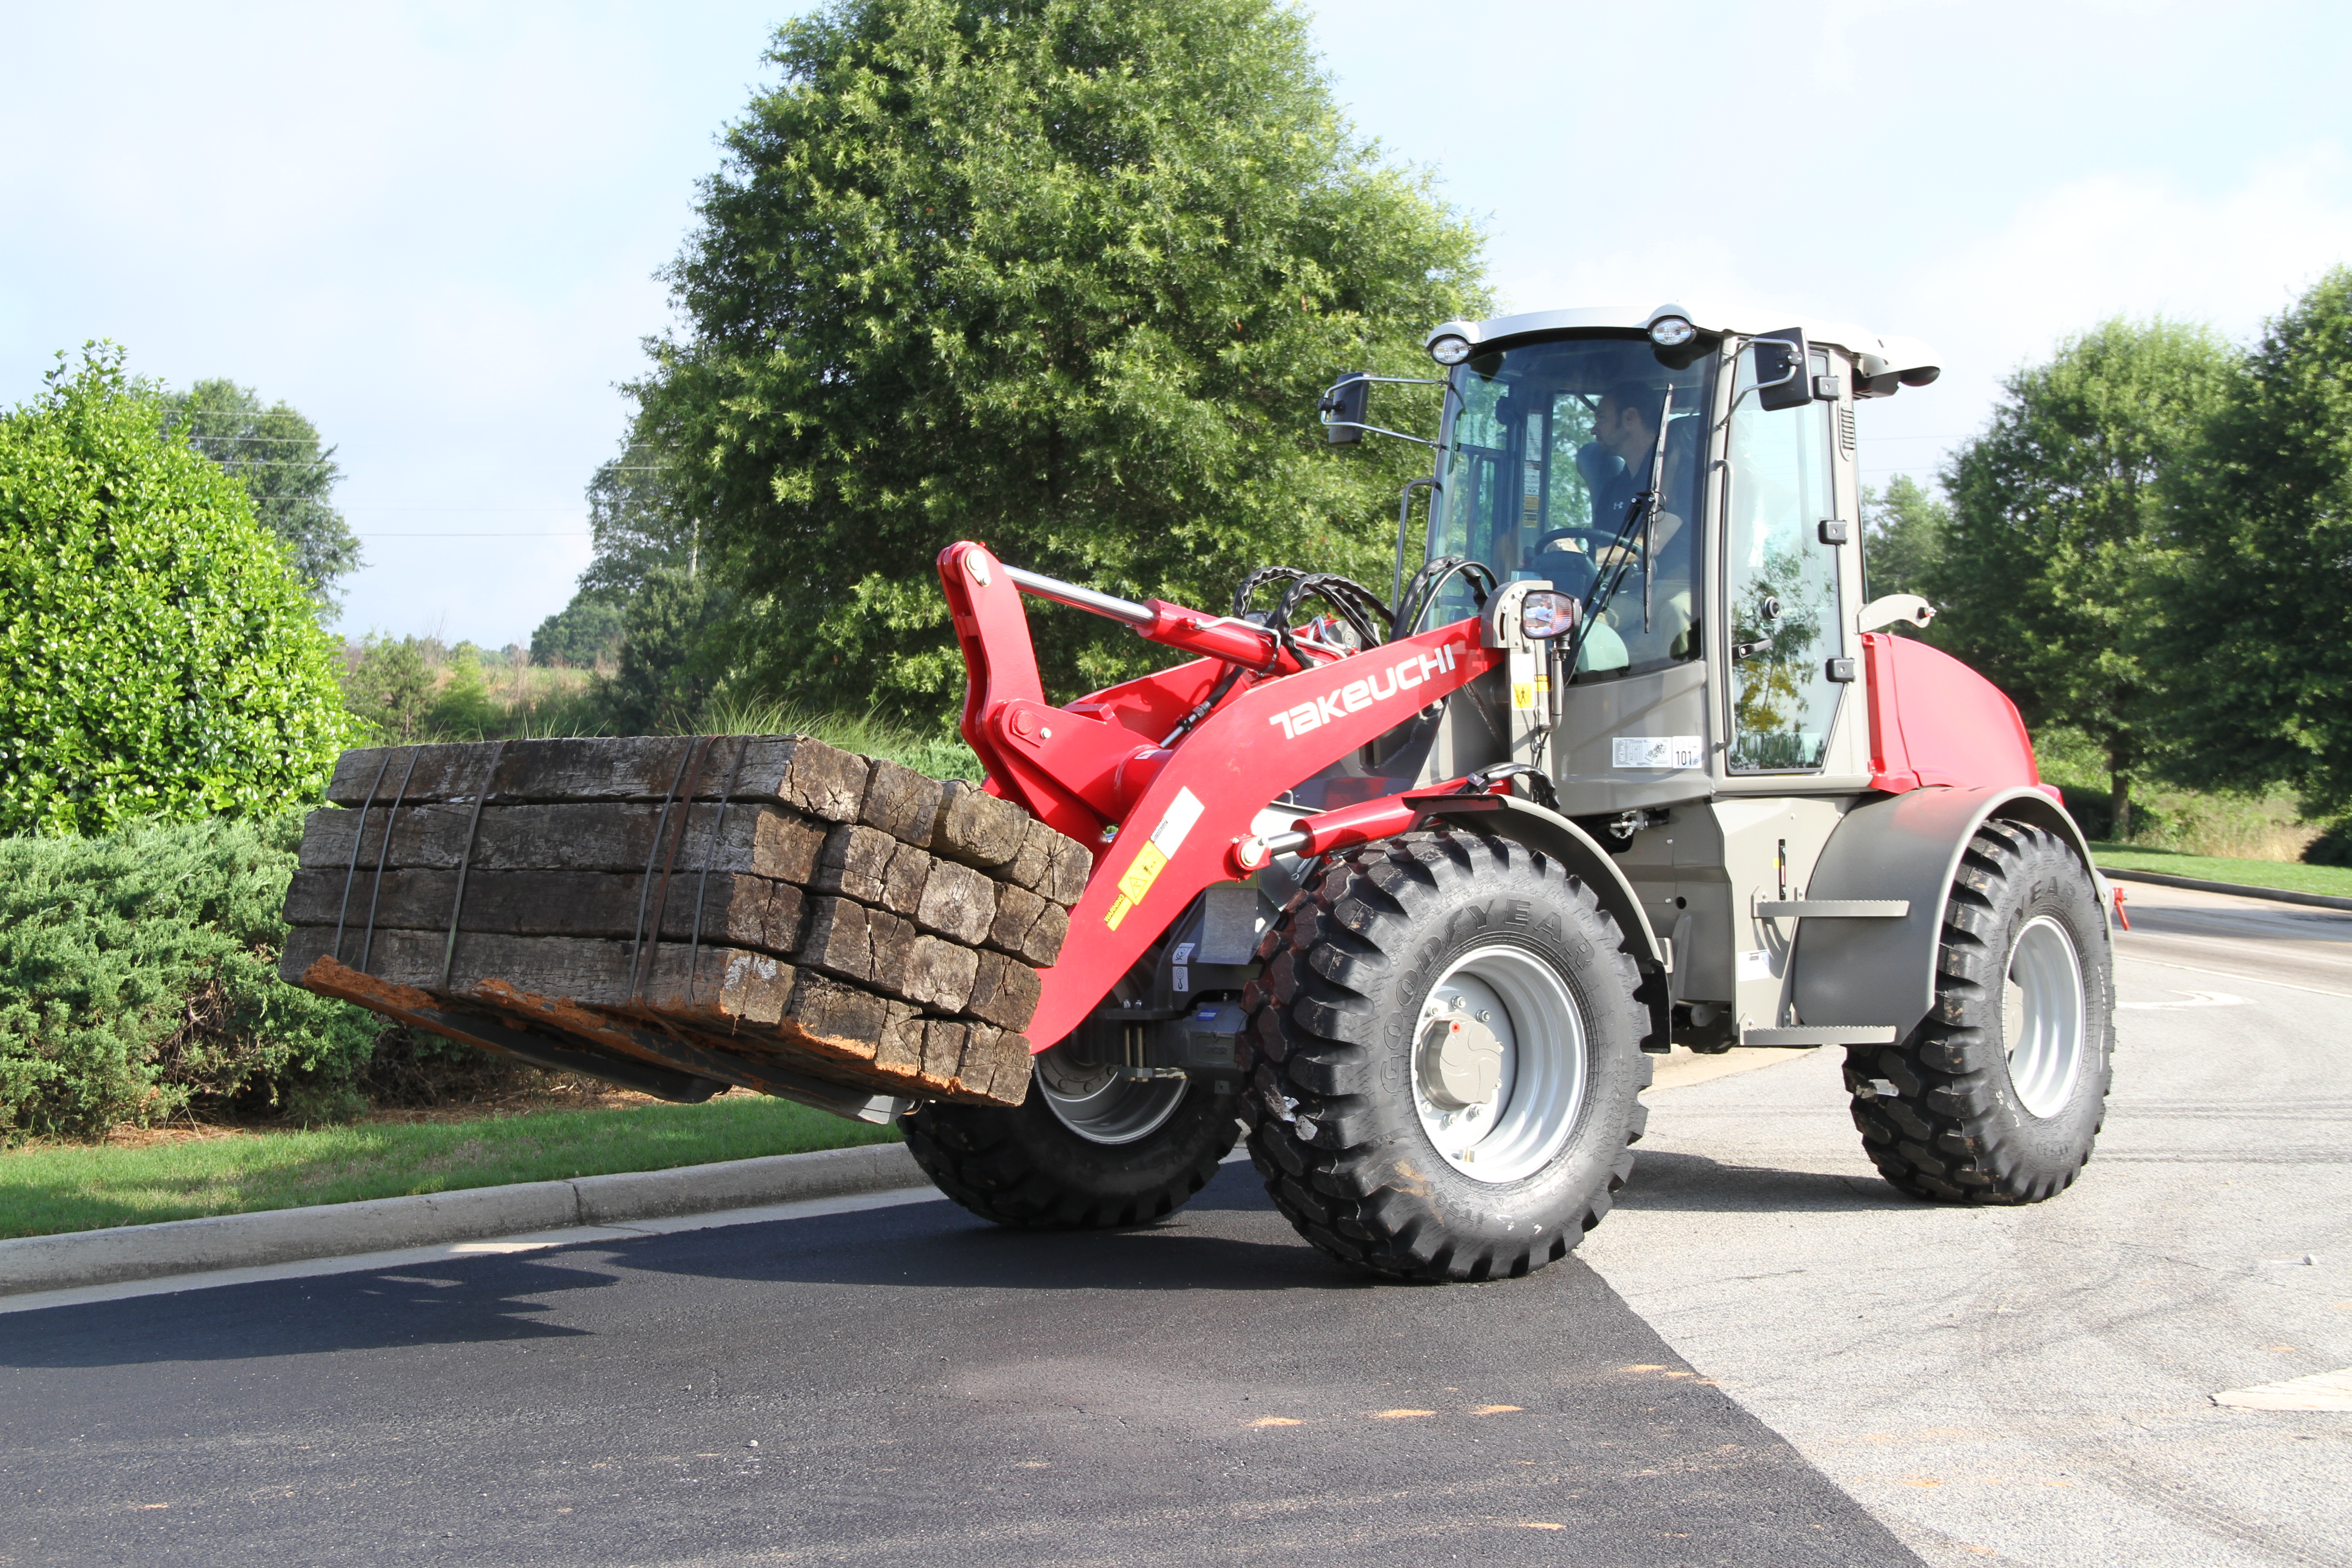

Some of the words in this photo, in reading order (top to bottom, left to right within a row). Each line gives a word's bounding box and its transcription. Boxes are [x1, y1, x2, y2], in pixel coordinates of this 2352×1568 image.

[1269, 644, 1455, 740] TAKEUCHI
[1676, 751, 1691, 765] 101
[1151, 817, 1166, 839] WARNING
[1103, 893, 1126, 921] WARNING
[1381, 893, 1595, 1094] GOODYEAR
